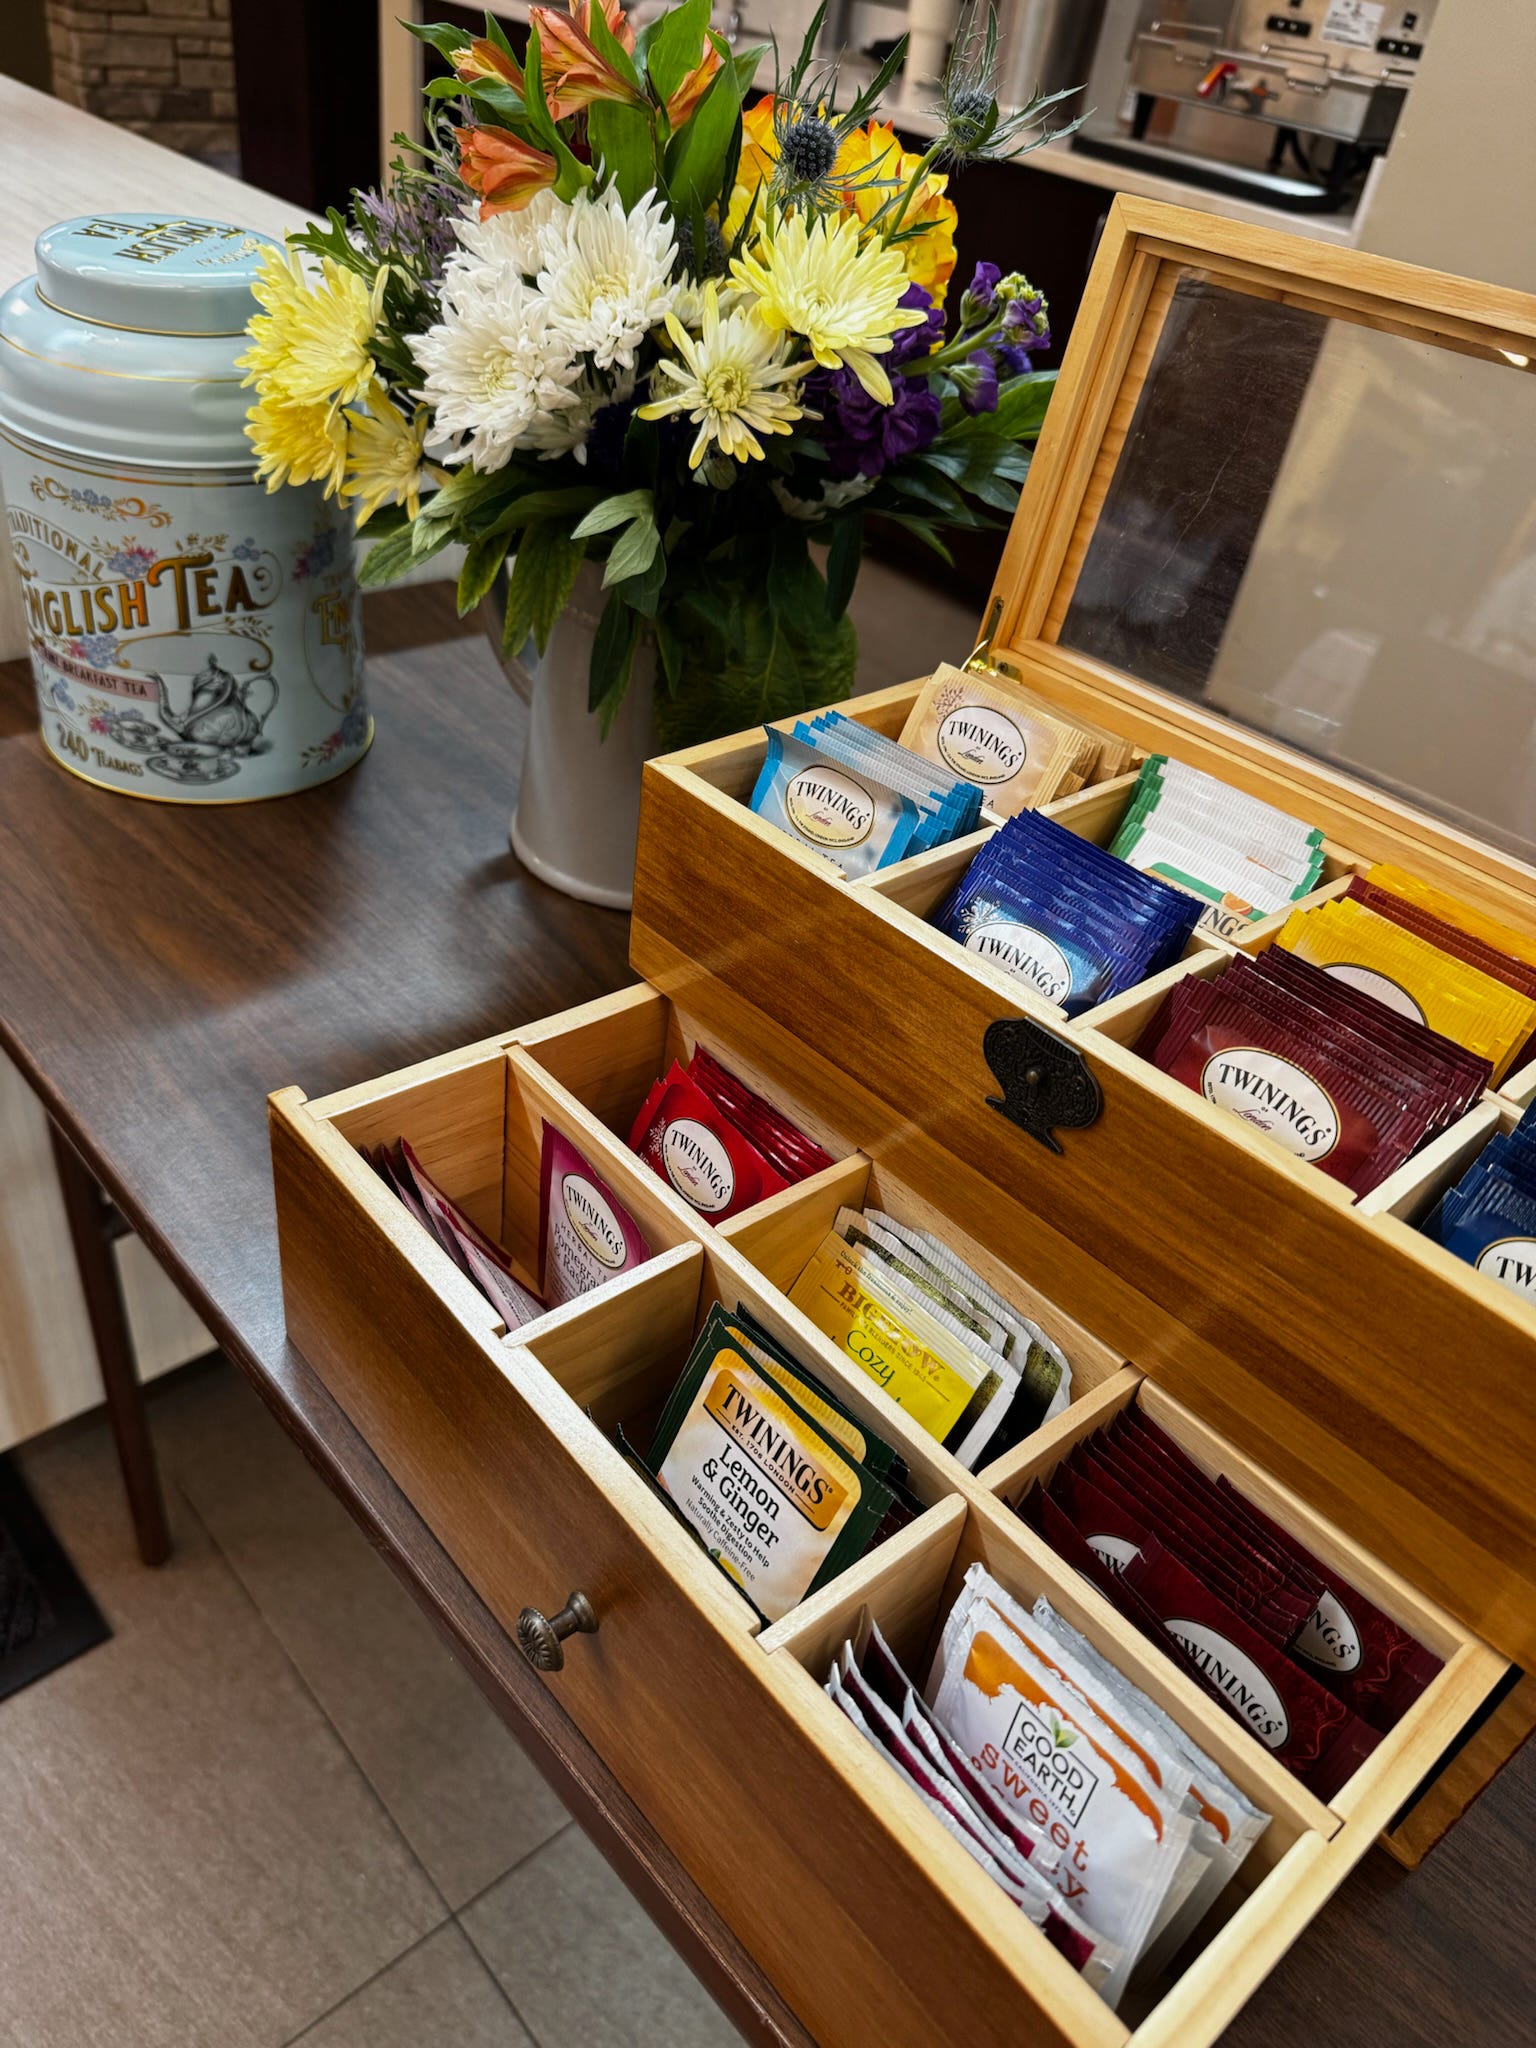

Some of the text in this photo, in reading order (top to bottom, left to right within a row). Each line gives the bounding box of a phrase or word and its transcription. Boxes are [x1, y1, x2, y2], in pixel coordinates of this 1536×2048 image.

[24, 581, 149, 636] NGLISH
[147, 551, 263, 630] TEA
[124, 682, 147, 697] TEA
[949, 720, 1019, 768] TWININGS
[796, 781, 867, 830] TWININGS
[978, 936, 1060, 997] TWININGS
[1219, 1063, 1326, 1146] TWININGS
[671, 1129, 728, 1199] TWININGS
[566, 1185, 622, 1255] TWININGS
[847, 1330, 896, 1388] Cozy
[721, 1384, 829, 1505] TWININGS
[731, 1425, 796, 1493] EST. 1706 LONDON
[686, 1498, 714, 1534] Naturally
[702, 1458, 780, 1548] & Ginger
[719, 1443, 780, 1520] Lemon
[691, 1475, 770, 1568] Warming & Zesty to Help
[697, 1496, 754, 1563] Soothe Digestion
[1013, 1737, 1076, 1810] EARTH
[1021, 1721, 1083, 1790] GOOD
[980, 1743, 1088, 1872] sweet
